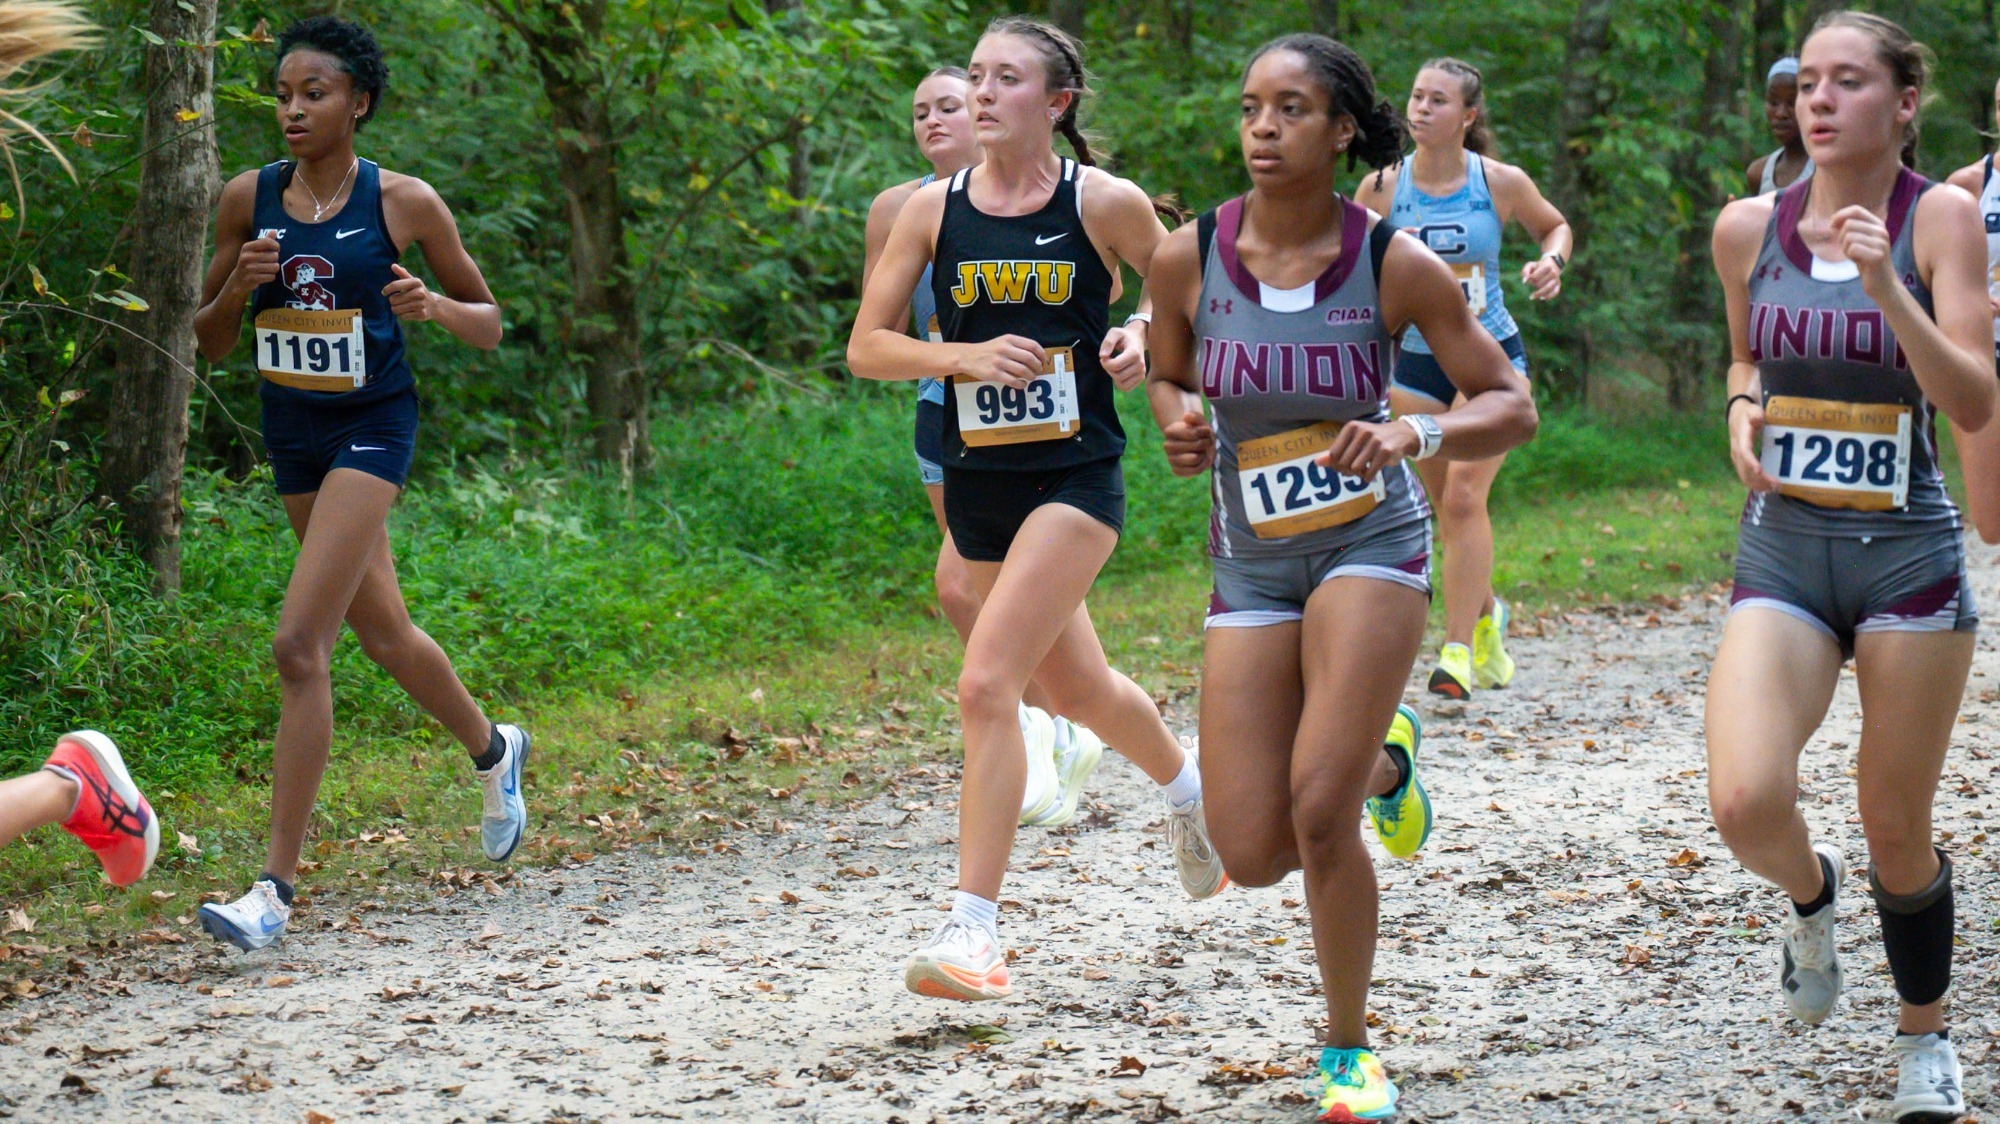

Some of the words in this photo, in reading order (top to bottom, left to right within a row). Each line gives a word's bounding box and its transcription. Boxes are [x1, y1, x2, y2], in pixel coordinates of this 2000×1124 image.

[1419, 222, 1467, 256] C
[950, 260, 1076, 308] JWU
[258, 313, 290, 325] QUEEN
[294, 316, 318, 327] CITY
[321, 316, 353, 327] INVIT
[1325, 307, 1374, 326] CIAA
[1750, 302, 1908, 371] UNIO
[264, 332, 350, 373] 1191
[1202, 336, 1383, 401] UNION
[975, 378, 1055, 425] 993
[1769, 405, 1817, 421] QUEEN
[1821, 409, 1854, 423] CITY
[1240, 443, 1279, 462] QUEEN
[1284, 435, 1313, 452] CITY
[1774, 431, 1897, 487] 1298
